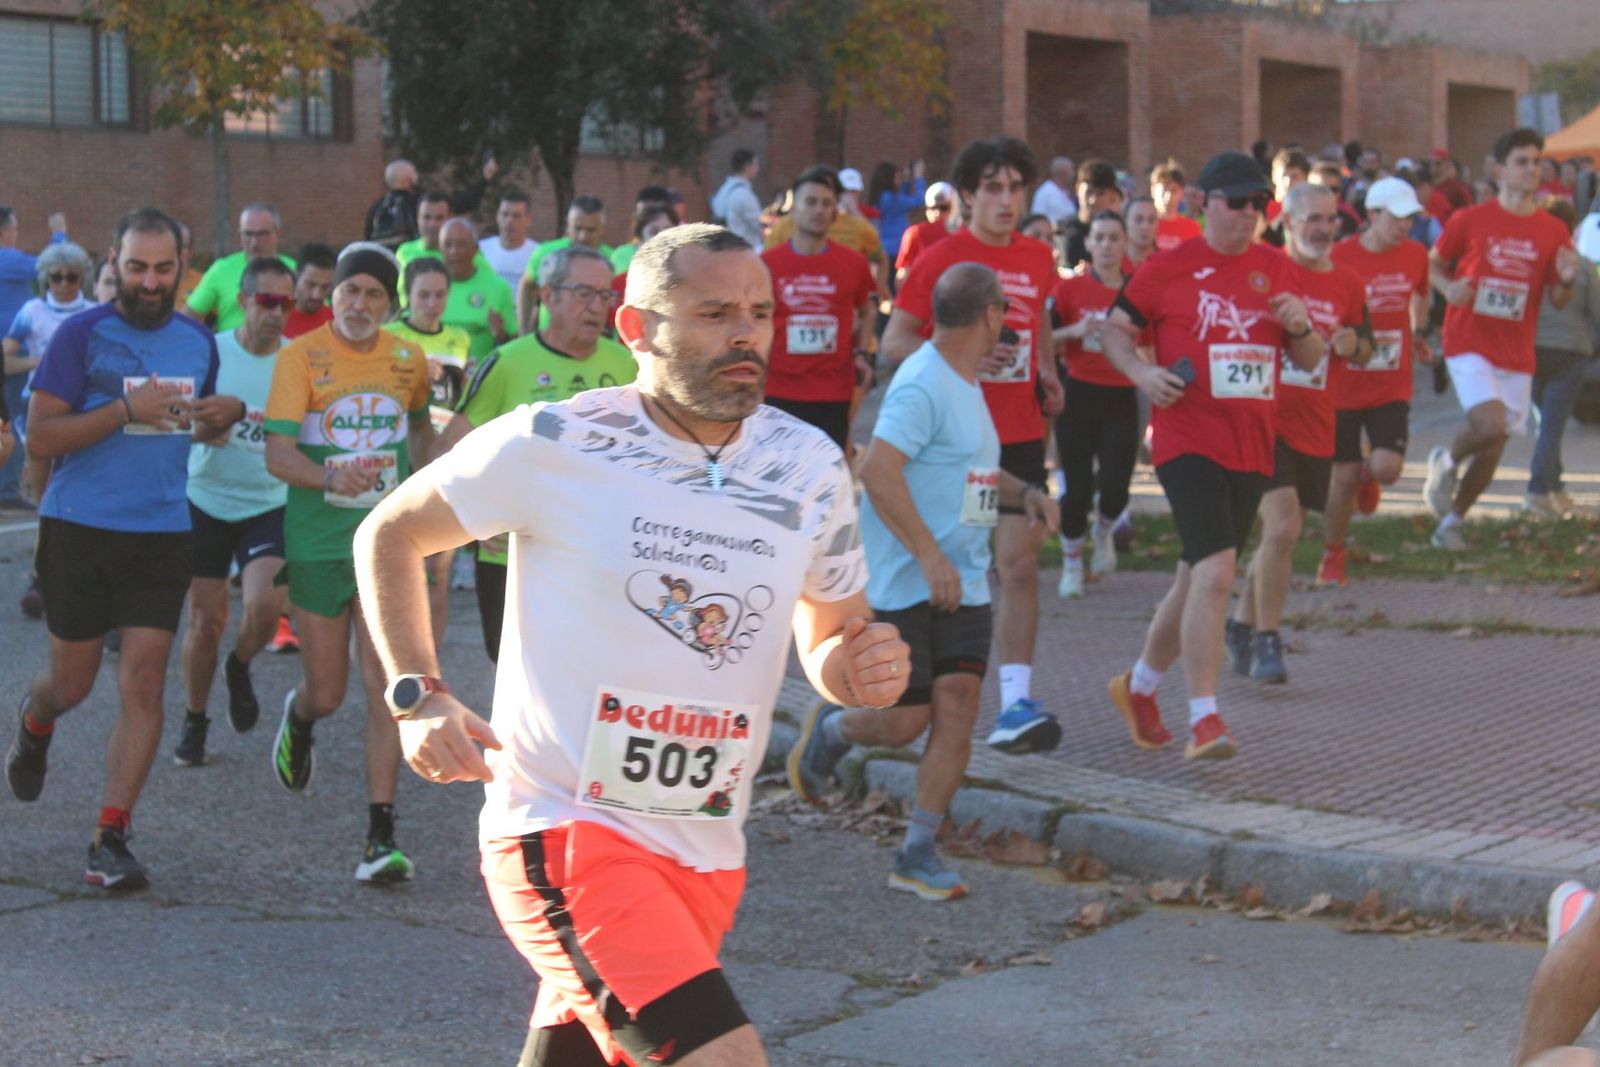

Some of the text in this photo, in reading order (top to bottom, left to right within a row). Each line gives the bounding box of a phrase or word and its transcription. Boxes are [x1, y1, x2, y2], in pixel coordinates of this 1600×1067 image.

[1228, 363, 1263, 383] 291
[332, 414, 398, 431] ALCER
[597, 692, 749, 740] bedunia
[621, 735, 718, 789] 503
